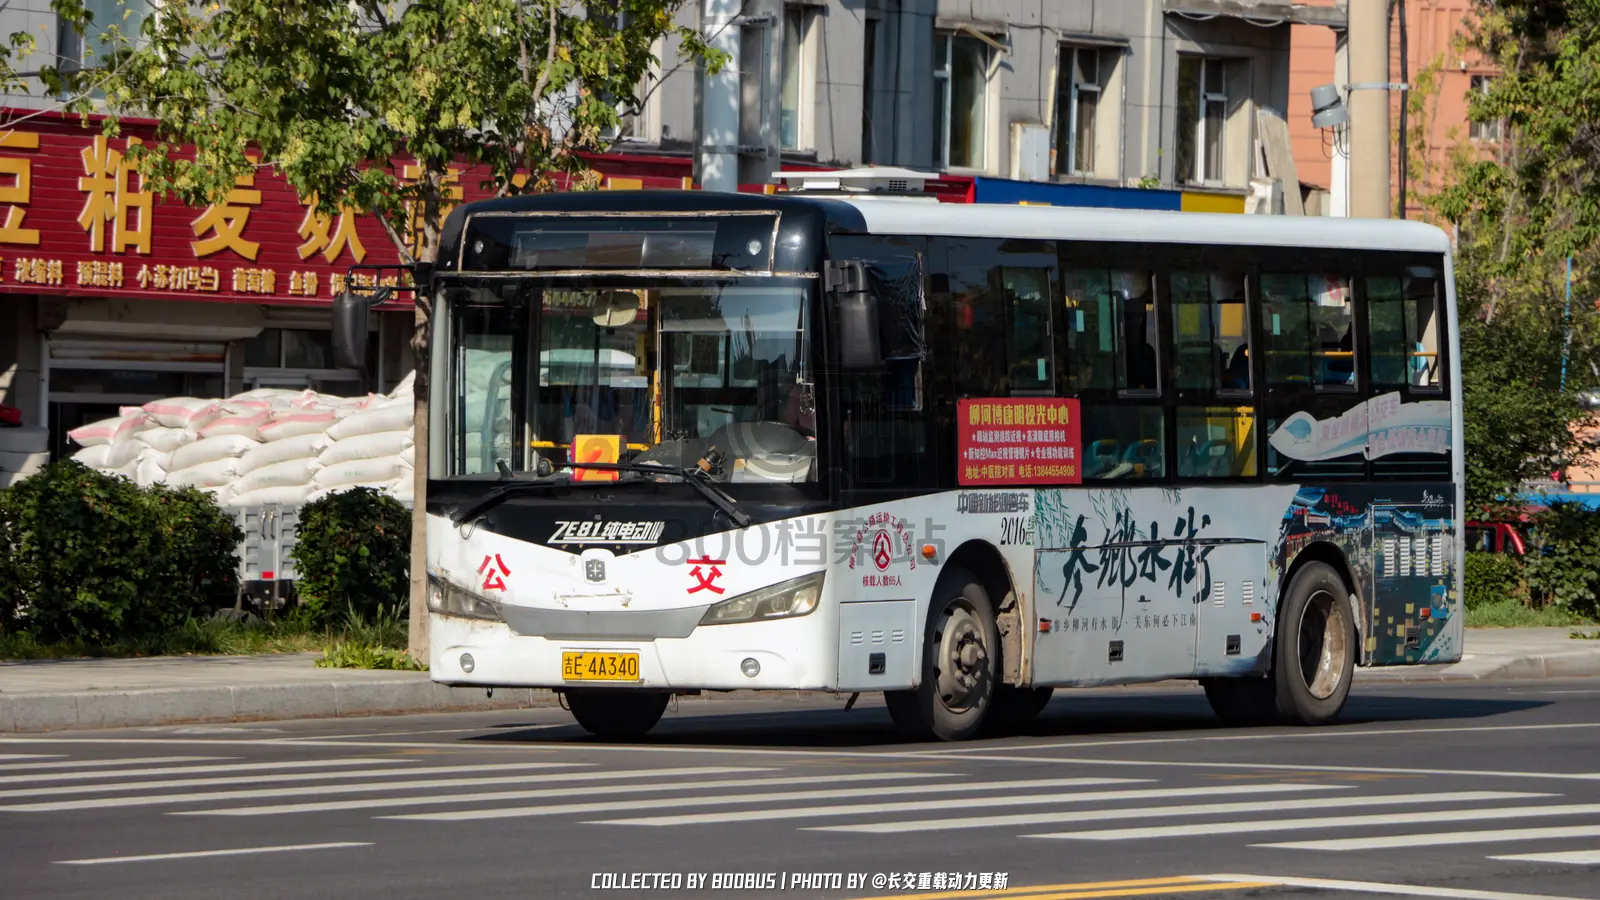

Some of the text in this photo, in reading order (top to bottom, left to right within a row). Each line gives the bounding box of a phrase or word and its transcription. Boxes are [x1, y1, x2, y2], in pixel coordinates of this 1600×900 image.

[15, 257, 64, 285] 浓缩料
[77, 260, 124, 287] 预混料
[288, 270, 318, 296] 鱼粉
[1000, 516, 1026, 546] 2016
[477, 553, 727, 595] 公 交
[862, 574, 902, 588] 核载人数65人
